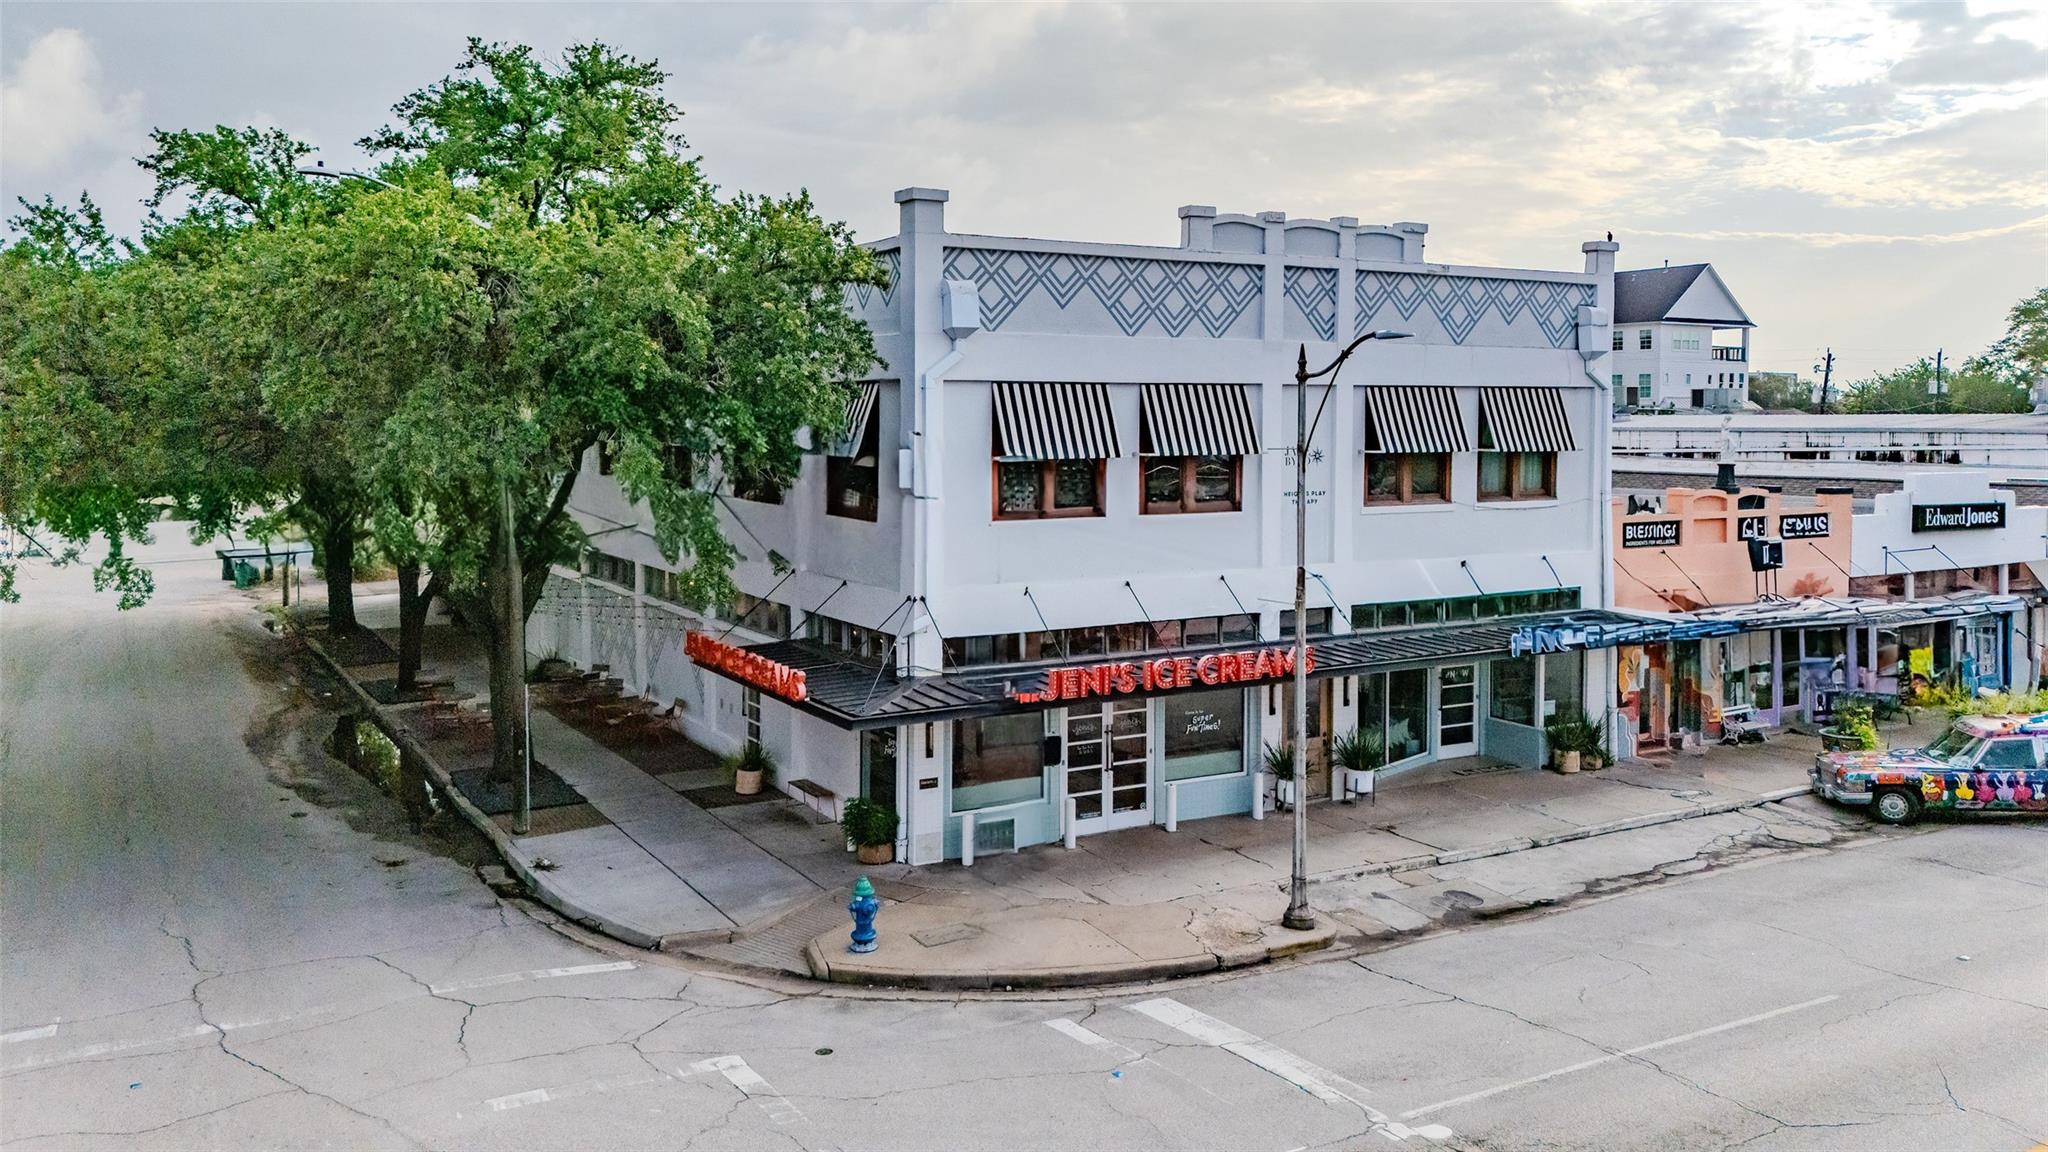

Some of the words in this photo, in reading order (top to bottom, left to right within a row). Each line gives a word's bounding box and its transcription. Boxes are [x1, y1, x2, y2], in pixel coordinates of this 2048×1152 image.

[1925, 507, 1966, 527] Edward
[1966, 507, 1999, 527] Jones
[1626, 524, 1676, 539] BLESSINGS
[1040, 661, 1137, 702] JENI'S
[1143, 656, 1193, 691] ICE
[1196, 644, 1316, 686] CREAMS
